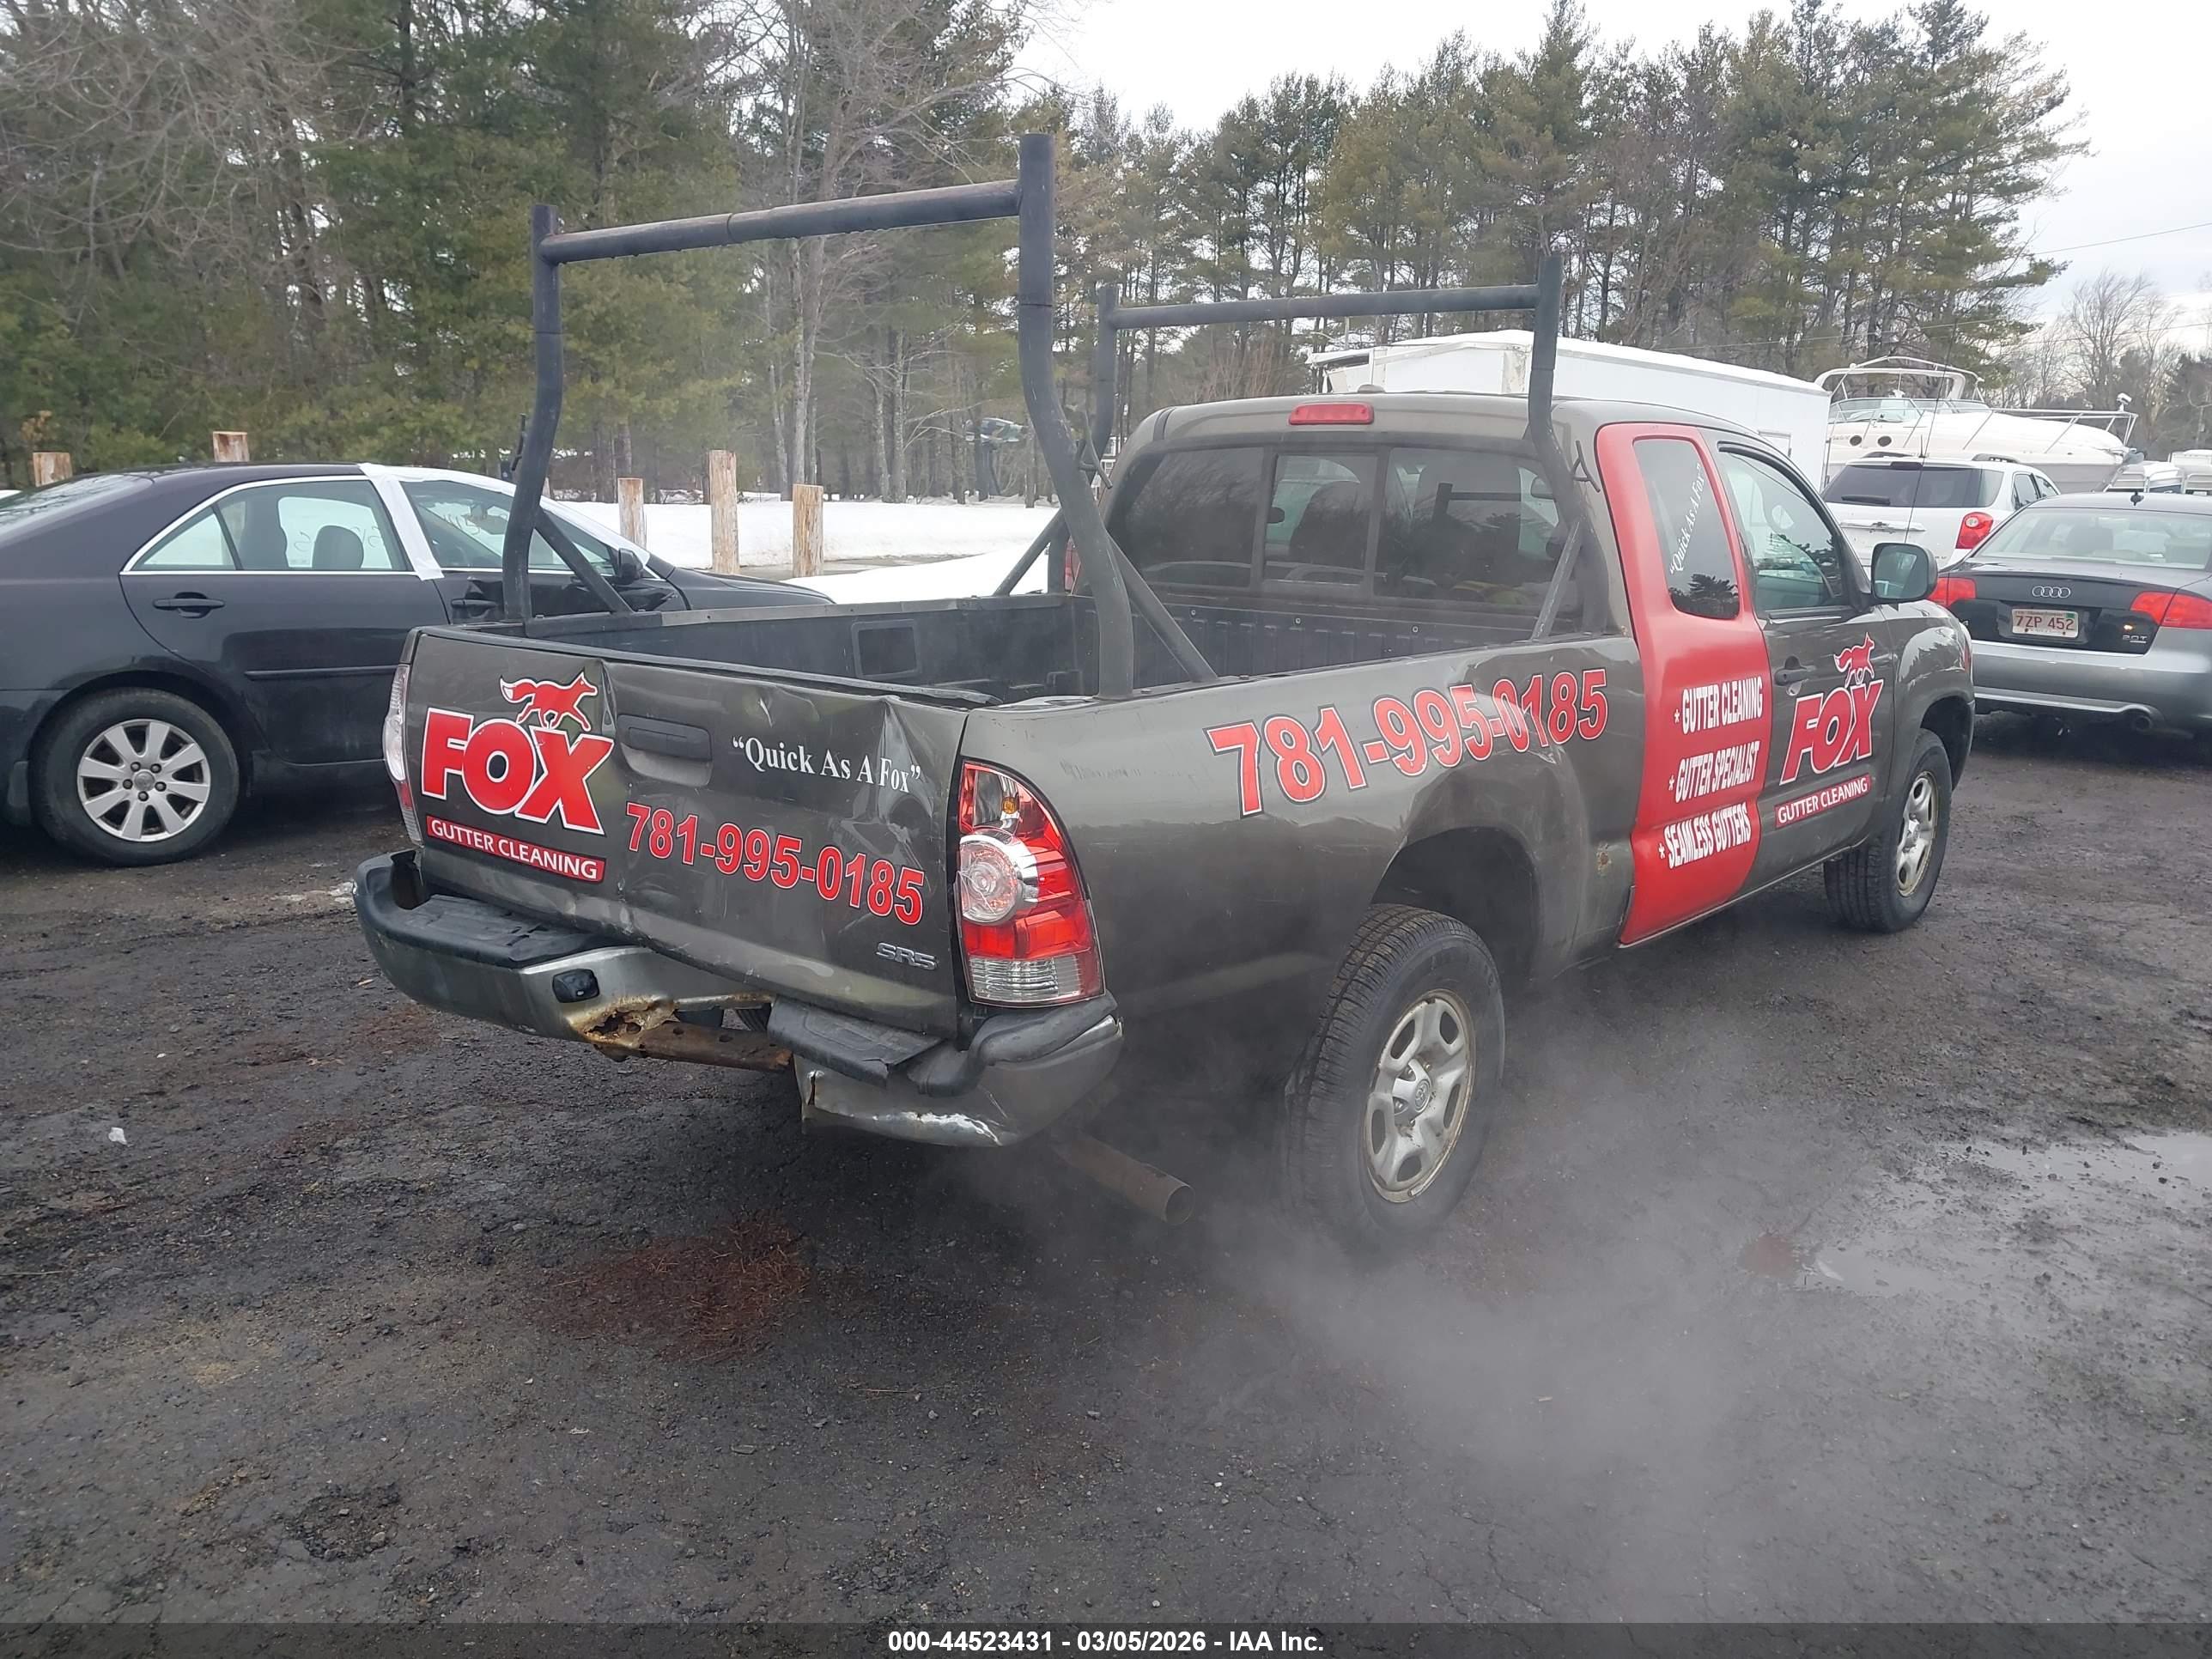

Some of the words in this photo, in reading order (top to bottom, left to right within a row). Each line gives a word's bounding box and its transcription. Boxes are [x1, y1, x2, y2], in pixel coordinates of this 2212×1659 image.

[1685, 510, 1697, 533] As
[1689, 496, 1699, 515] A
[2015, 615, 2042, 629] 7ZP
[2047, 617, 2075, 631] 452
[1681, 684, 1720, 735] GUTTER
[1721, 676, 1763, 726] CLEANING
[1779, 679, 1883, 786] FOX
[422, 708, 614, 835] FOX
[732, 736, 815, 774] “Quick
[820, 749, 851, 780] As
[856, 755, 873, 784] A
[879, 757, 921, 793] Fox”
[1205, 668, 1609, 817] 781-995-0185
[1675, 752, 1715, 804] GUTTER
[1712, 740, 1760, 793] SPECIALIST
[1778, 795, 1820, 824] GUTTER
[1820, 777, 1869, 809] CLEANING
[431, 819, 495, 853] GUTTER
[497, 838, 597, 879] CLEANING
[626, 801, 925, 926] 781-995-0185
[1663, 814, 1714, 870] SEAMLESS
[1711, 801, 1752, 854] GUTTERS
[876, 942, 935, 970] SR5
